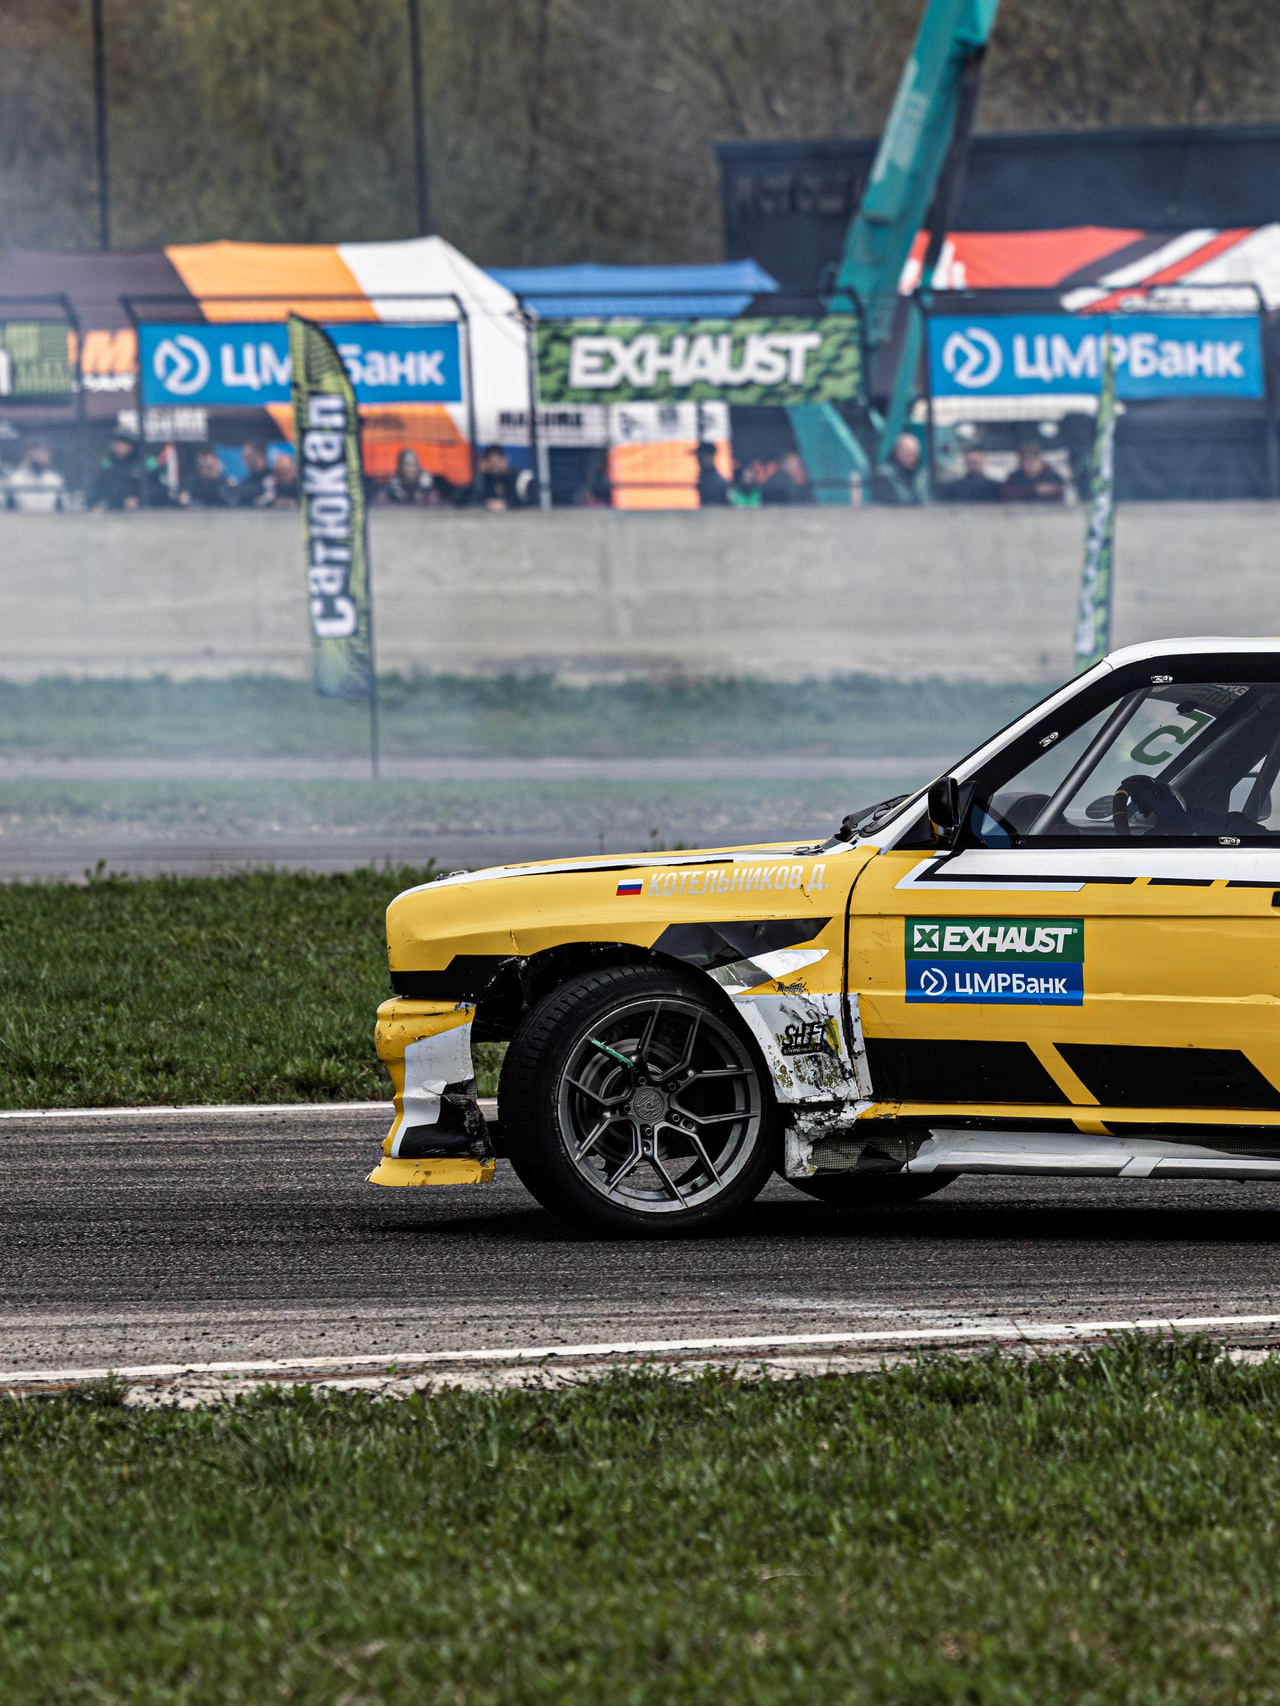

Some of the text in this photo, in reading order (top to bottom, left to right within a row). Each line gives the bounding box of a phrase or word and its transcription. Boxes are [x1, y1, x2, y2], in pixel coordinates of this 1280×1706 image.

[569, 332, 822, 388] EXHAUST
[648, 863, 830, 898] КОТЕЛЬНИКОВ Д.
[954, 972, 1068, 995] ЦМРБанк
